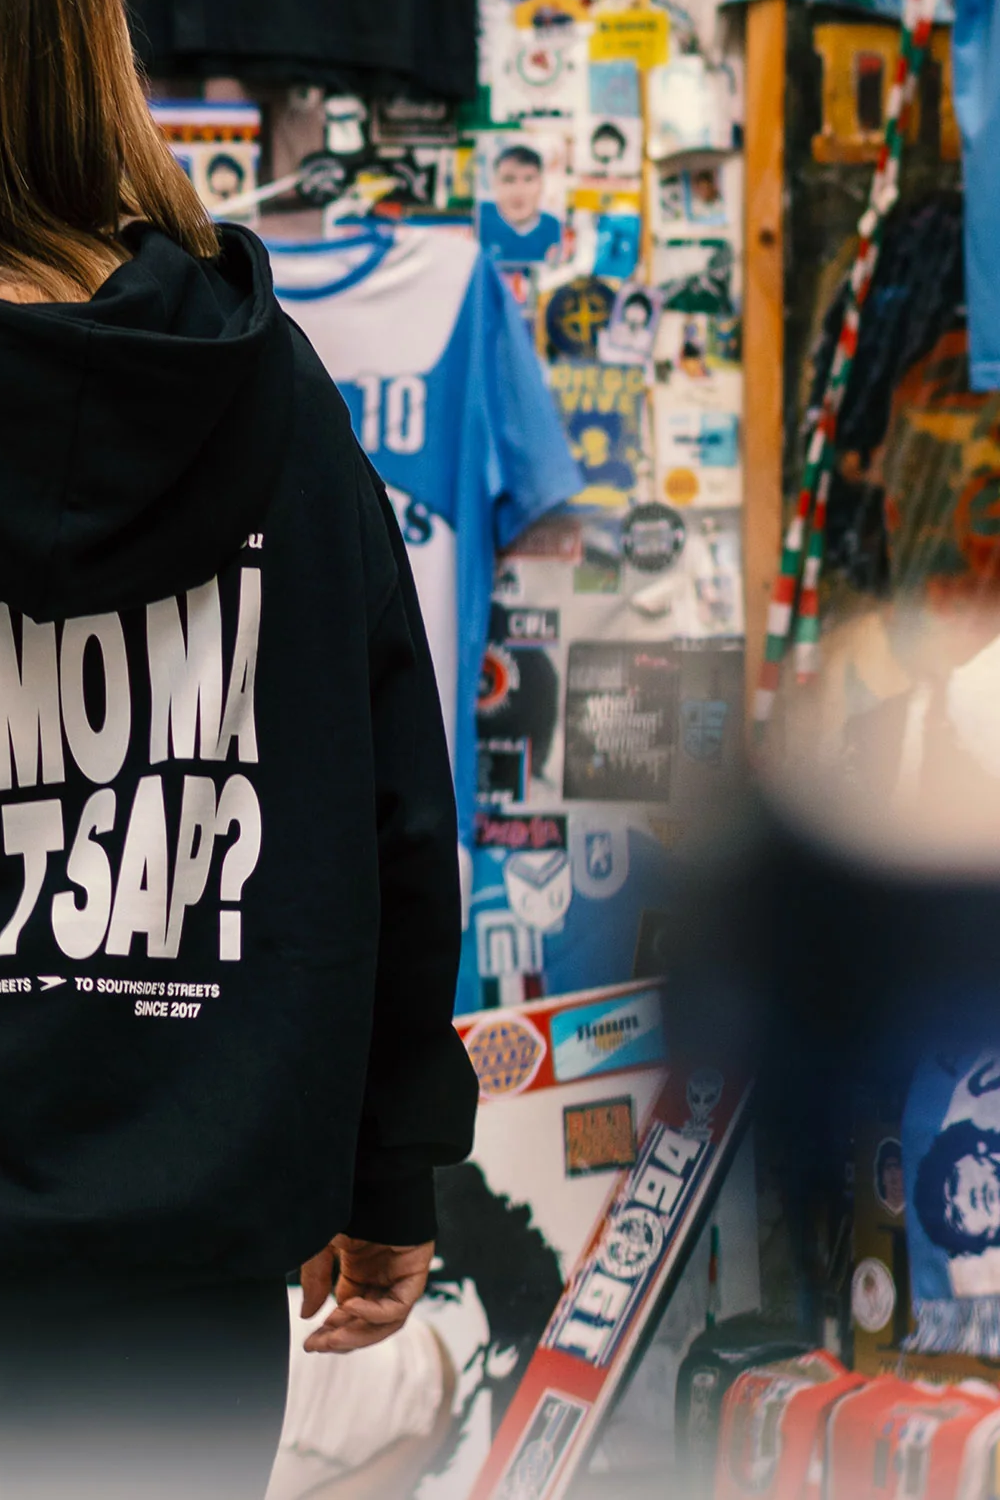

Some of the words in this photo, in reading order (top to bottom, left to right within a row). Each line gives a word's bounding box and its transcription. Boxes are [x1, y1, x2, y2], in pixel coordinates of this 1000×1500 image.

[354, 374, 427, 455] 10
[146, 567, 262, 766] MA
[74, 977, 94, 992] TO
[96, 978, 166, 997] SOUTHSIDE'S
[166, 982, 221, 998] STREETS
[134, 1000, 169, 1016] SINCE
[170, 1002, 202, 1018] 2017
